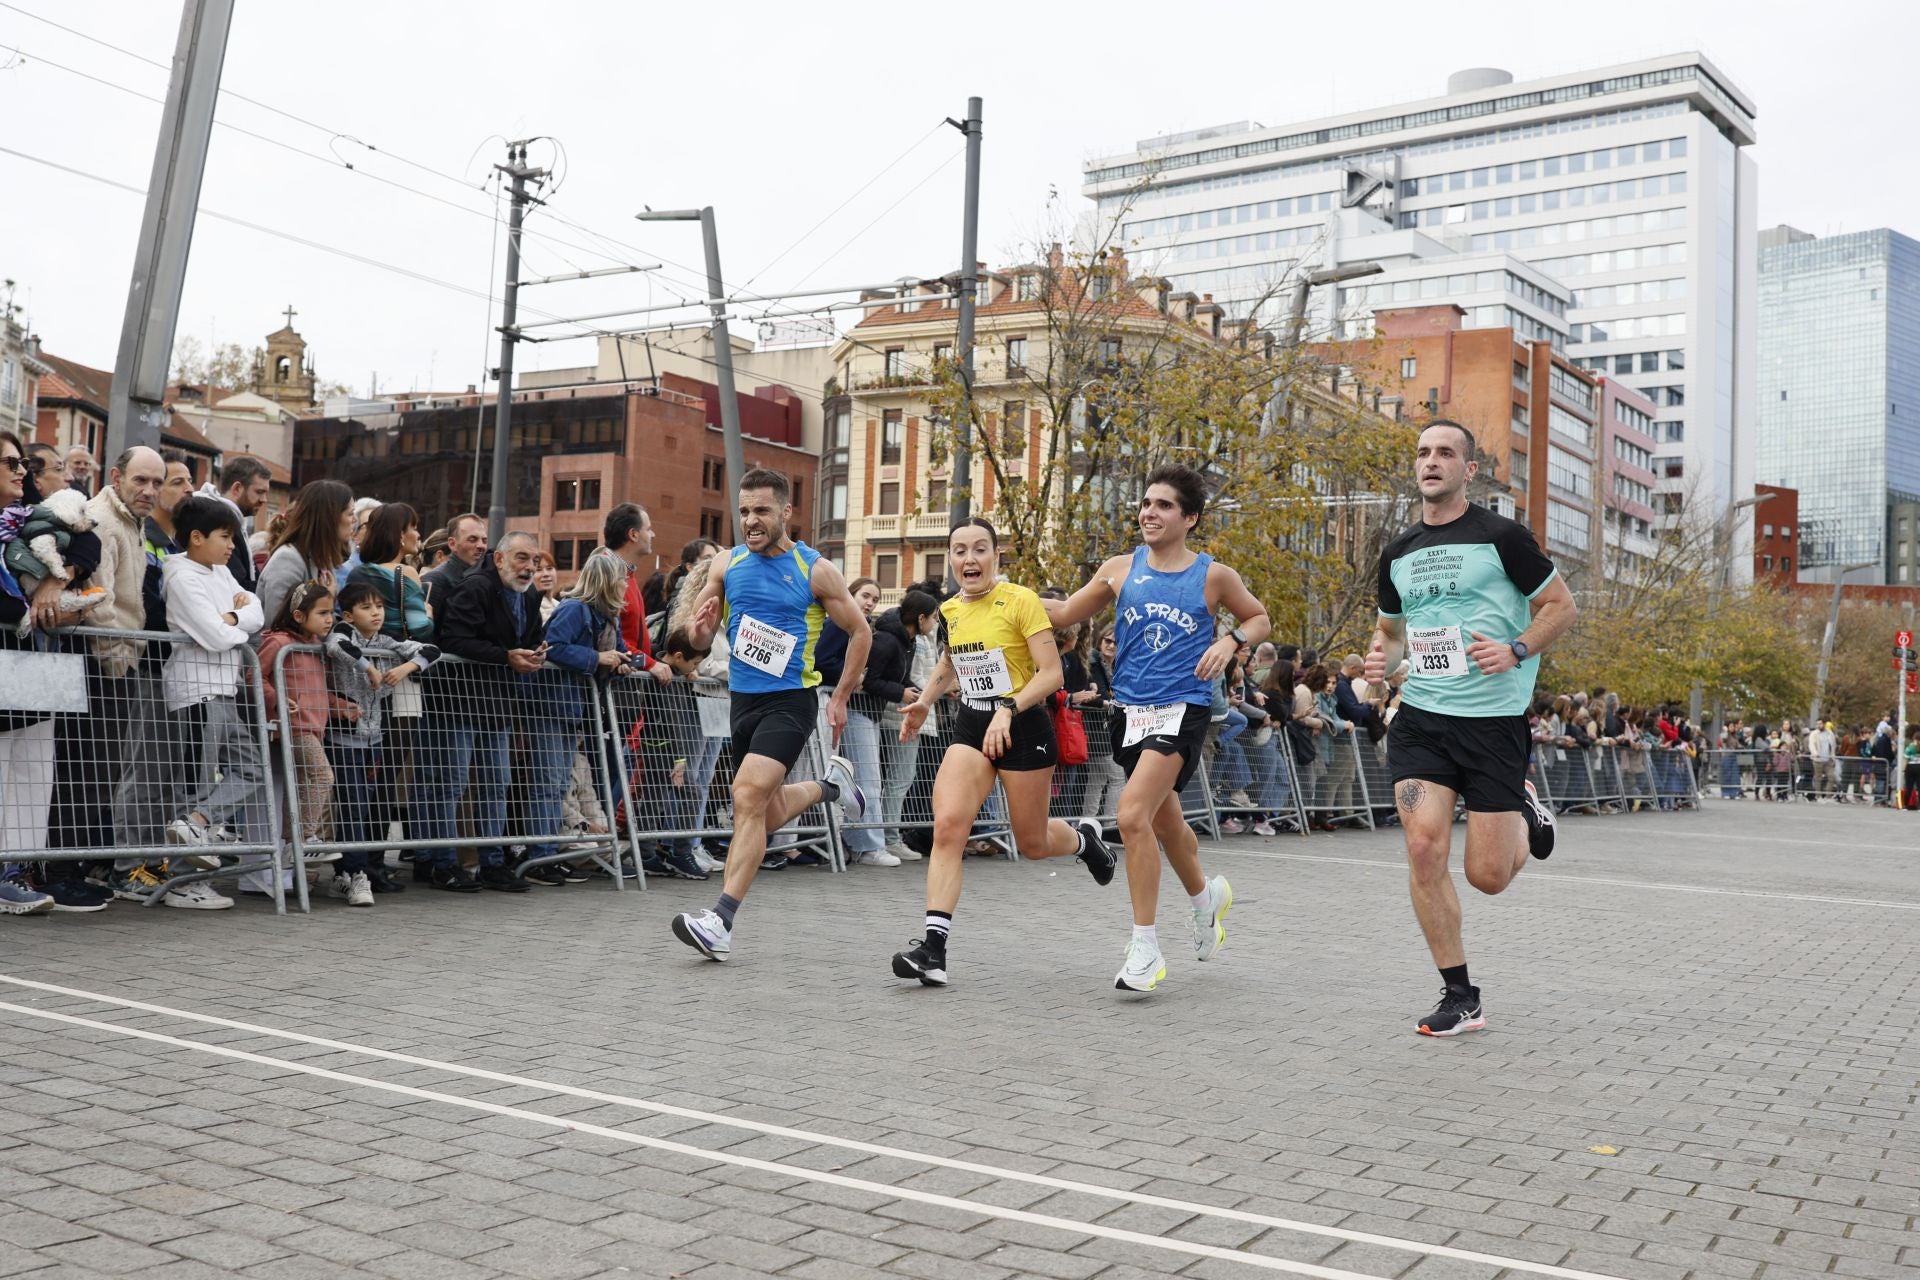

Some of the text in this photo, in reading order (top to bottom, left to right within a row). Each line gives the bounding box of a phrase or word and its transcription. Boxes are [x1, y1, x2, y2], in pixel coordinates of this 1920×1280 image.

[1124, 603, 1198, 634] EL PRADO
[757, 625, 783, 639] CORREO
[741, 628, 762, 644] XXXVI
[762, 638, 786, 650] SANTURCE
[761, 642, 785, 654] BILBAO
[1412, 641, 1430, 653] XXXVI
[744, 643, 772, 665] 2766
[966, 654, 988, 662] CORREO
[1422, 654, 1449, 669] 2333
[959, 665, 975, 675] XXXVI
[976, 662, 999, 670] SANTURCE
[976, 667, 1000, 675] BILBAO
[969, 676, 994, 691] 1138
[1146, 704, 1172, 712] CORREO
